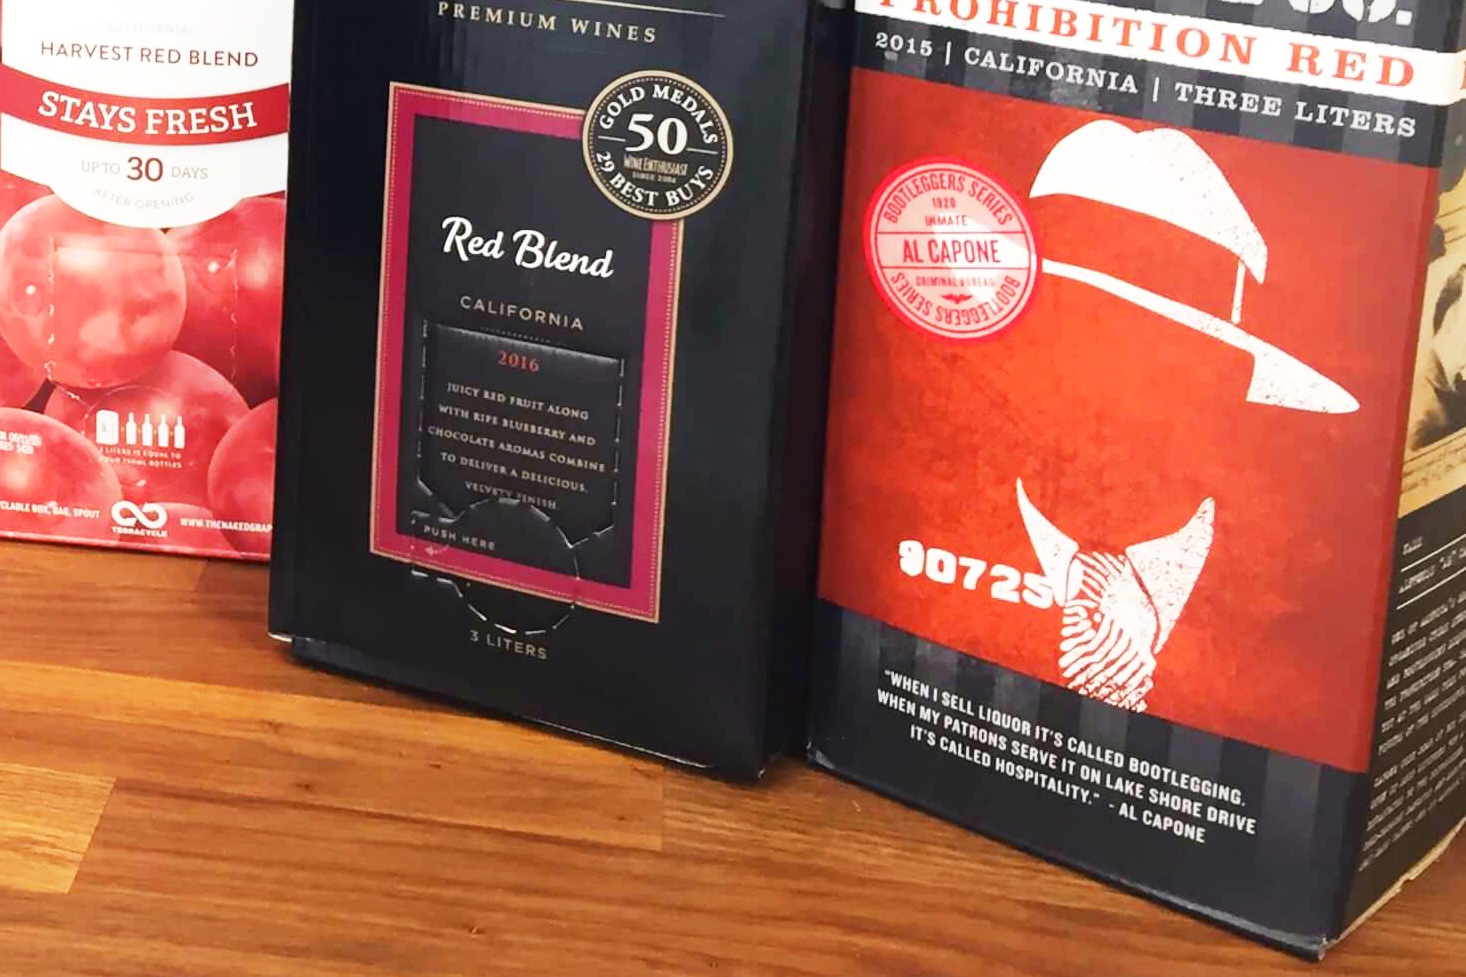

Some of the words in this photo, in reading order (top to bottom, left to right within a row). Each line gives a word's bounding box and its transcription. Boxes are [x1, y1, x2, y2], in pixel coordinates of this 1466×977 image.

[437, 0, 557, 32] PREMIUM
[570, 18, 657, 43] WINES
[41, 41, 133, 62] HARVEST
[140, 48, 181, 64] RED
[189, 50, 259, 67] BLEND
[1287, 40, 1416, 89] RED
[875, 31, 933, 56] 2015
[963, 46, 1138, 95] CALIFORNIA
[1174, 83, 1282, 118] THREE
[1292, 102, 1417, 138] LITERS
[38, 90, 136, 134] STAYS
[145, 101, 257, 135] FRESH
[599, 86, 645, 130] GOLD
[652, 84, 719, 144] MEDALS
[625, 113, 688, 155] 50
[81, 160, 99, 173] UP
[101, 162, 121, 175] TO
[126, 156, 164, 182] 30
[171, 166, 209, 180] DAYS
[596, 151, 615, 173] 29
[610, 173, 659, 206] BEST
[665, 165, 714, 207] BUYS
[883, 173, 966, 224] BOOTLEGGERS
[967, 181, 1013, 225] SERIES
[442, 216, 504, 261] Red
[514, 228, 614, 279] Blend
[902, 239, 924, 264] AL
[928, 239, 1001, 264] CAPONE
[460, 295, 584, 331] CALIFORNIA
[891, 272, 933, 317] SERIES
[935, 275, 1021, 326] BOOTLEGGERS
[498, 350, 540, 372] 2016
[447, 382, 480, 398] JUICY
[483, 389, 506, 403] RED
[509, 395, 545, 412] FRUIT
[547, 404, 589, 421] ALONG
[438, 404, 469, 420] WITH
[473, 411, 499, 426] RIPE
[502, 415, 566, 439] BLUEBERRY
[568, 431, 597, 446] AND
[142, 450, 169, 460] EQUAL
[170, 452, 182, 460] TO
[427, 426, 495, 449] CHOCOLATE
[498, 441, 546, 460] AROMAS
[549, 453, 606, 472] COMBINE
[440, 451, 456, 463] TO
[460, 456, 508, 475] DELIVER
[510, 468, 518, 477] A
[464, 481, 512, 499] VELVETY
[73, 508, 100, 519] SPOUT
[111, 526, 167, 538] TERRACYCLE
[423, 525, 456, 543] PUSH
[462, 535, 495, 551] HERE
[897, 538, 1054, 611] 90725
[468, 629, 480, 644] 3
[486, 633, 548, 660] LITERS
[877, 688, 915, 717] WHEN
[919, 704, 941, 727] MY
[944, 715, 1007, 752] PATRONS
[1011, 739, 1057, 770] SERVE
[1061, 757, 1076, 775] IT
[1080, 764, 1102, 784] ON
[1105, 772, 1144, 801] LAKE
[1149, 787, 1211, 819] SHORE
[1207, 806, 1256, 835] DRIVE
[933, 687, 939, 703] I
[942, 690, 975, 717] SELL
[978, 705, 1032, 738] LIQUOR
[1035, 725, 1063, 748] IT'S
[1067, 737, 1124, 769] CALLED
[1129, 757, 1246, 807] BOOTLEGGING.
[910, 724, 935, 747] IT'S
[939, 736, 991, 768] CALLED
[1118, 802, 1139, 822] AL
[1142, 810, 1206, 844] CAPONE
